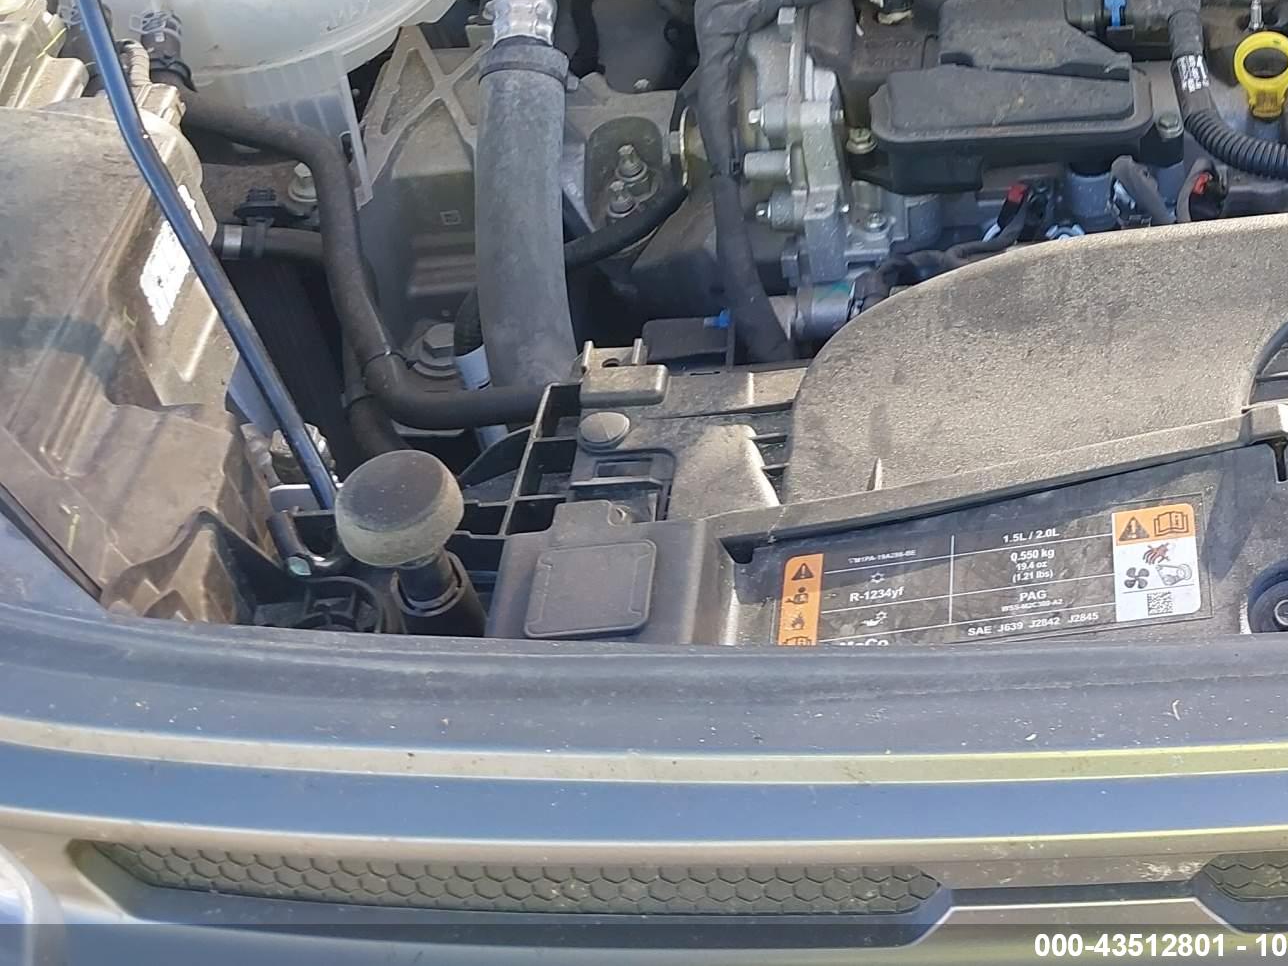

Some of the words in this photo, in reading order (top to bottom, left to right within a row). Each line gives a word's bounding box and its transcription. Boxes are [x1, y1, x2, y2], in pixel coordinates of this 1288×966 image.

[1003, 532, 1027, 544] 1.5L
[1035, 527, 1060, 539] 2.0L
[1010, 549, 1039, 562] 0.550
[1041, 548, 1055, 559] kg
[1016, 561, 1034, 571] 19.4
[1012, 571, 1033, 584] (1.21
[1036, 569, 1053, 579] lbs)
[849, 586, 905, 602] R-1234yf
[1019, 590, 1047, 602] PAG
[967, 625, 992, 636] SAE
[997, 621, 1024, 633] J639
[1028, 616, 1061, 629] J2842
[1067, 611, 1099, 623] J2845
